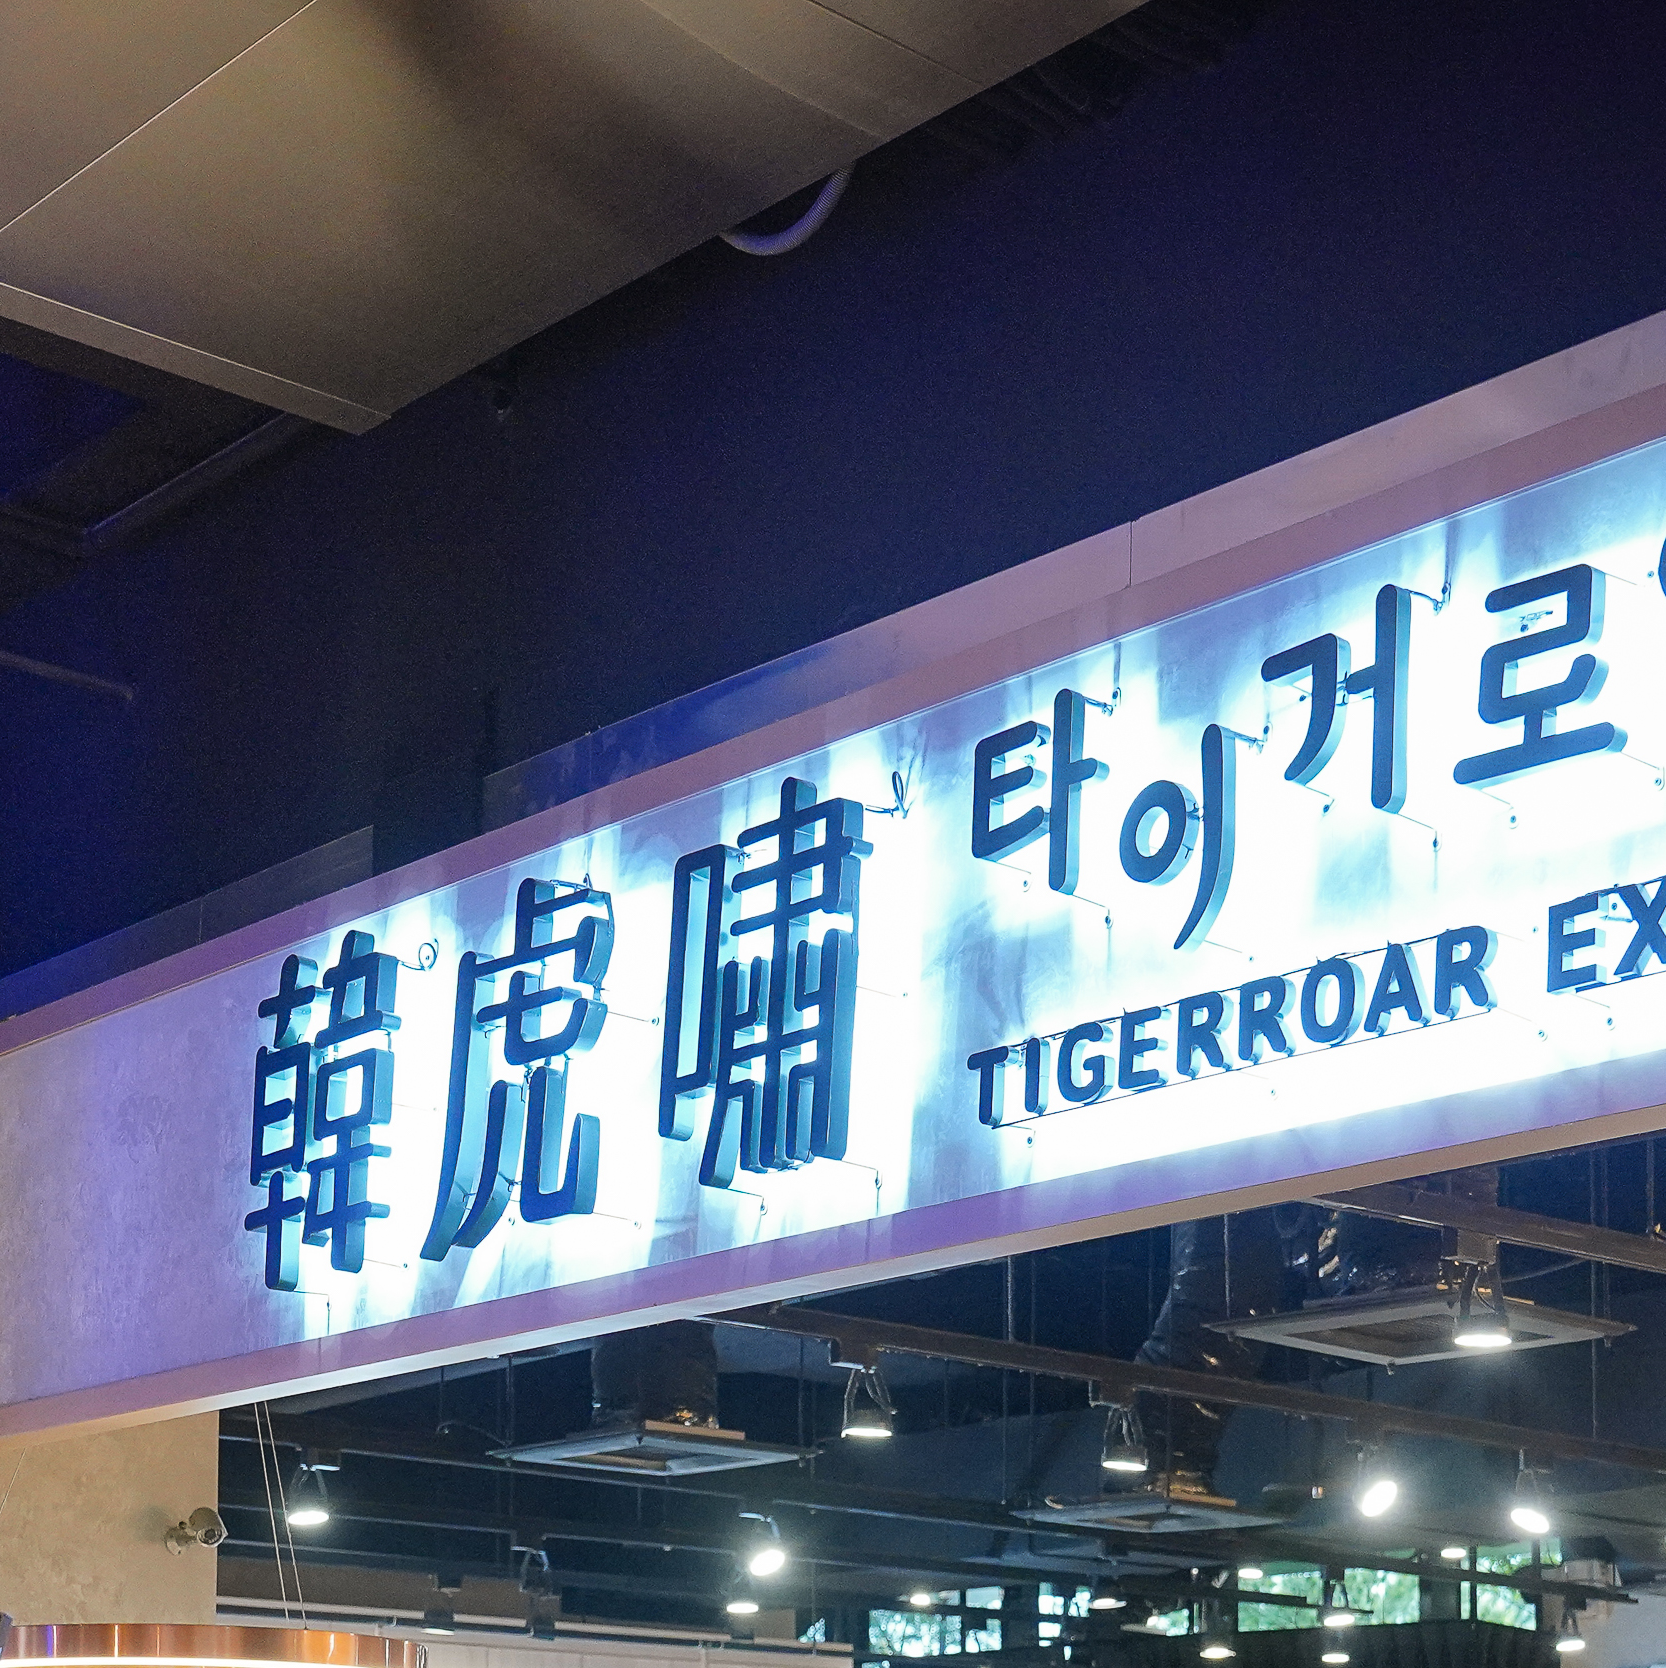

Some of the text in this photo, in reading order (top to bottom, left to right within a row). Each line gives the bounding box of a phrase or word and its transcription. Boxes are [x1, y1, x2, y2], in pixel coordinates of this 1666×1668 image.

[245, 776, 873, 1292] 韓虎嘯
[967, 926, 1499, 1127] TIGERROAR
